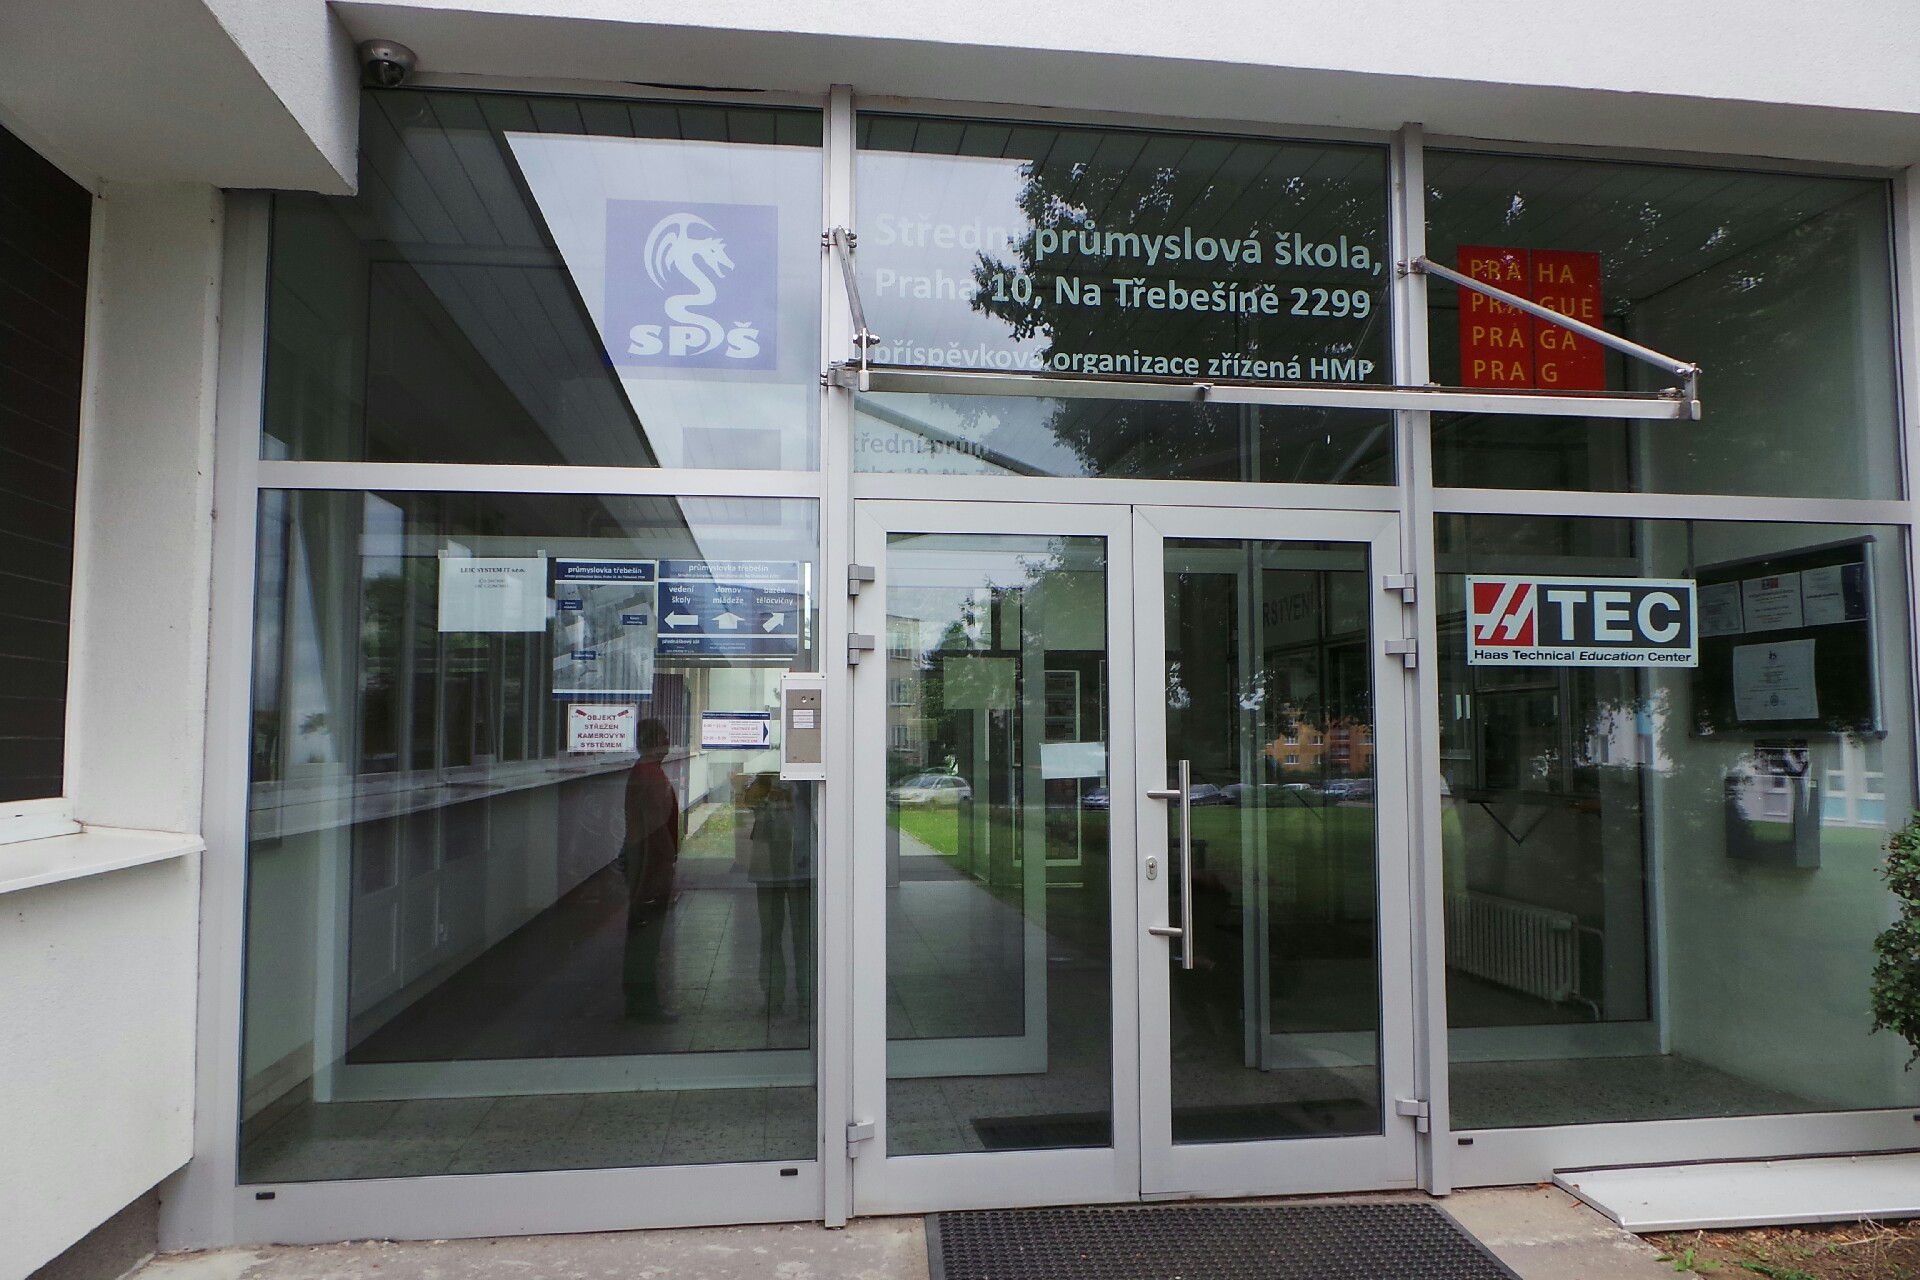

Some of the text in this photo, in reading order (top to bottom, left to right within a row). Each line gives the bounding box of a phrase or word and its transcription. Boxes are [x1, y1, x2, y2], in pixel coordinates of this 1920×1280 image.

[875, 212, 1382, 276] Střední průmyslová škola,
[875, 267, 1371, 319] Praha 10, Na Třebešíně 2299
[627, 321, 760, 359] SPŠ
[874, 339, 1374, 381] příspěvková organizace zřízená HMP
[567, 565, 612, 574] průmyslovka
[668, 585, 695, 593] vedení
[715, 585, 741, 593] domov
[671, 596, 691, 604] školy
[756, 597, 793, 605] tělocvičny
[1474, 649, 1692, 662] Haas Technical Education Center
